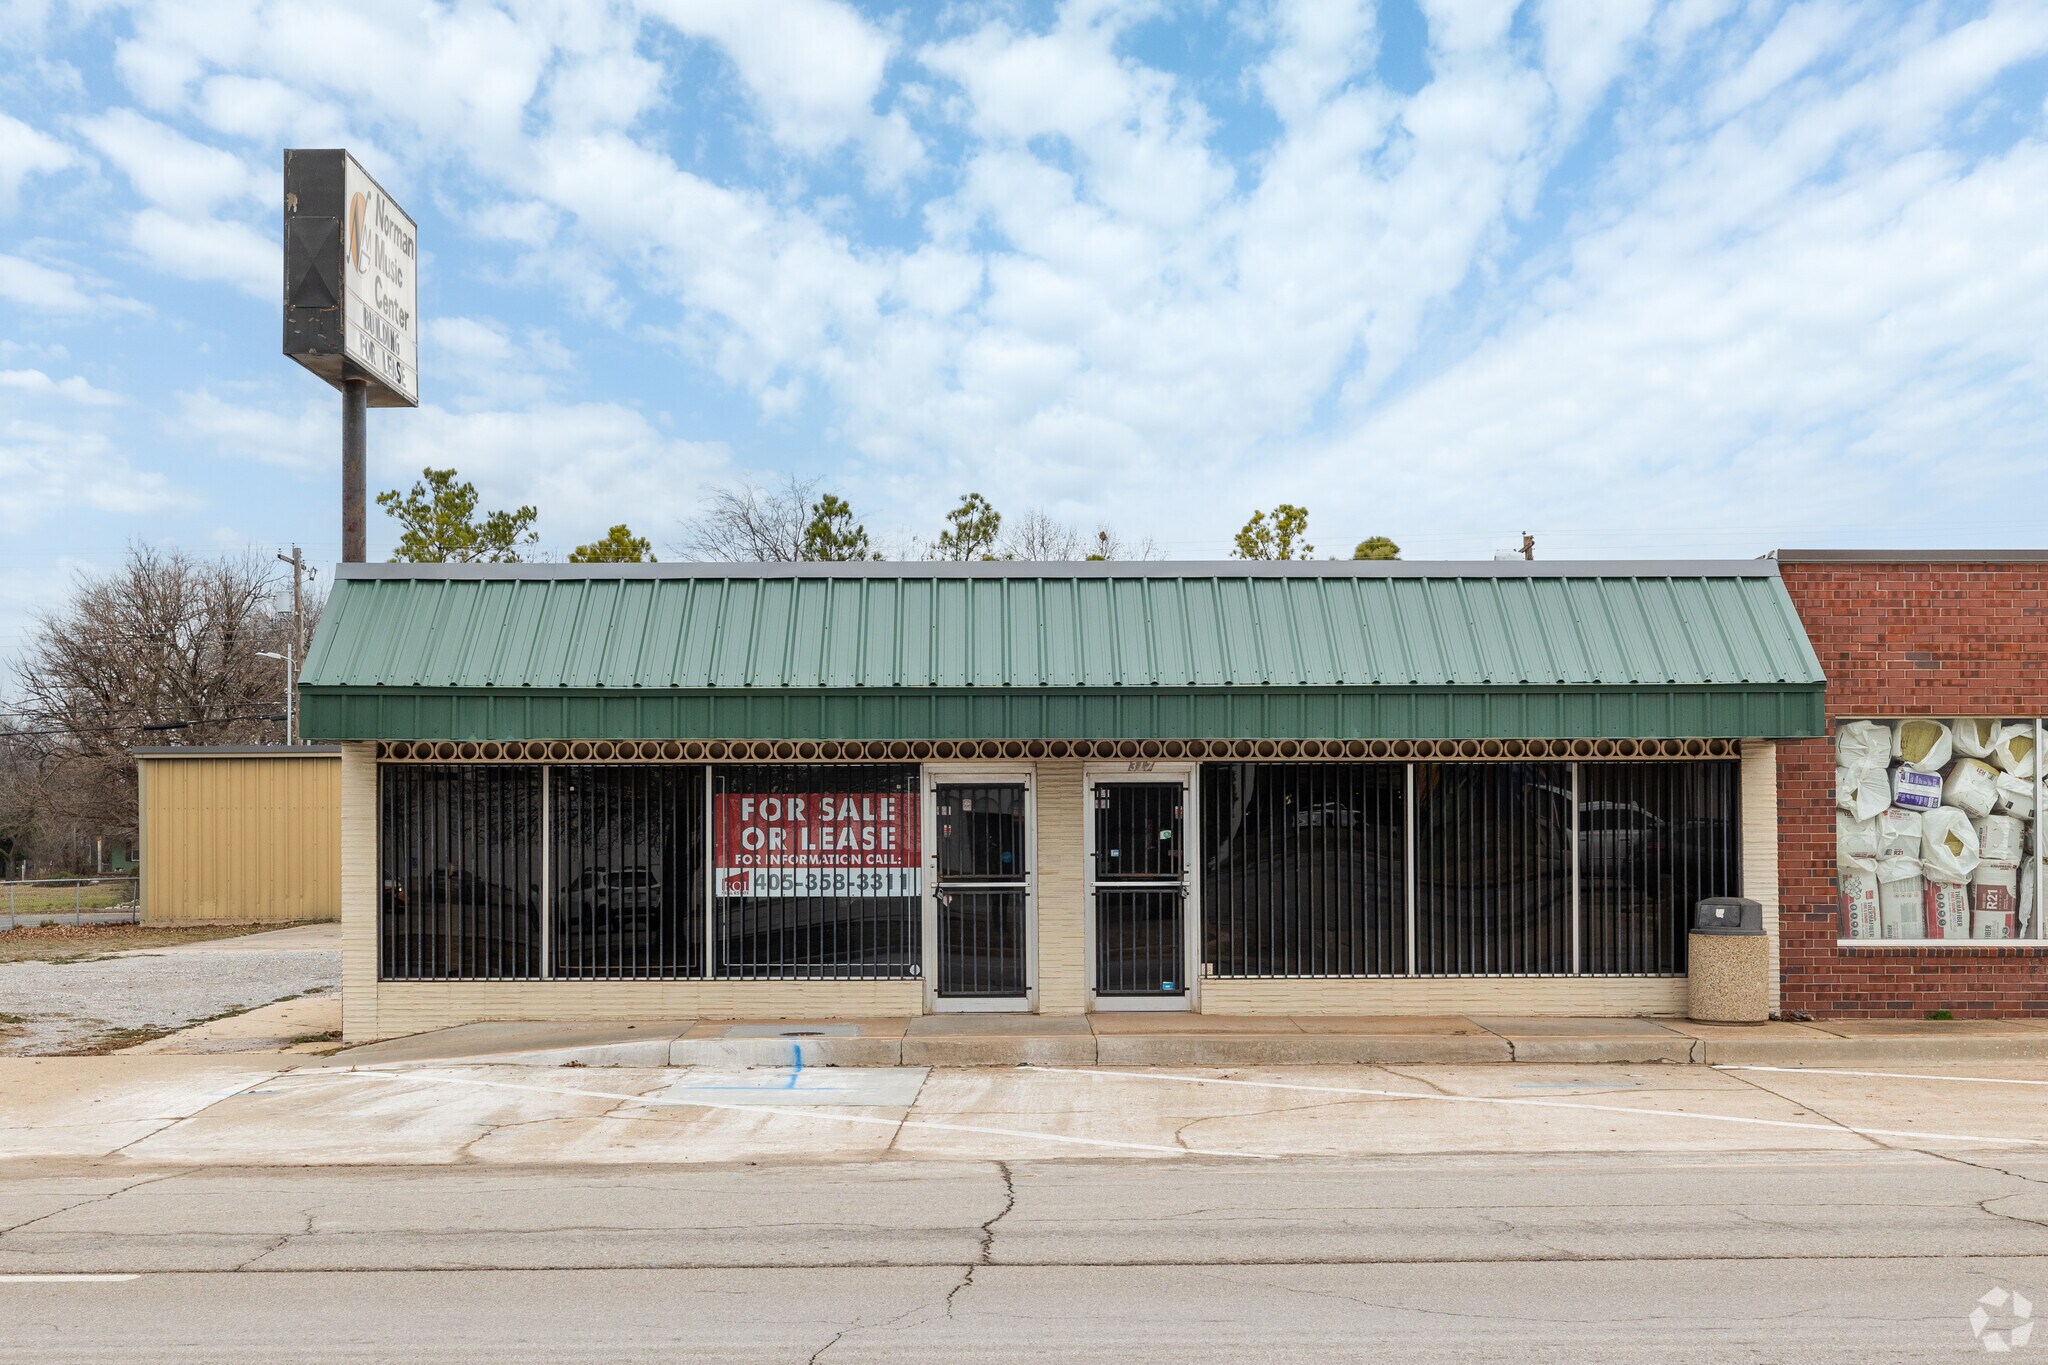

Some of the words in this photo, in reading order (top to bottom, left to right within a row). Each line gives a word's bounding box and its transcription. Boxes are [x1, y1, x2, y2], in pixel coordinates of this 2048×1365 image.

[375, 193, 414, 260] Norman
[375, 234, 403, 288] Music
[374, 275, 410, 331] Center
[742, 797, 805, 821] FOR
[819, 797, 896, 821] SALE
[742, 826, 787, 850] OR
[801, 826, 896, 850] LEASE
[735, 854, 762, 865] FOR
[765, 854, 861, 865] INFORMATION
[866, 854, 902, 865] CALL:
[755, 873, 908, 890] 405-358-3311
[1986, 889, 1998, 910] R21
